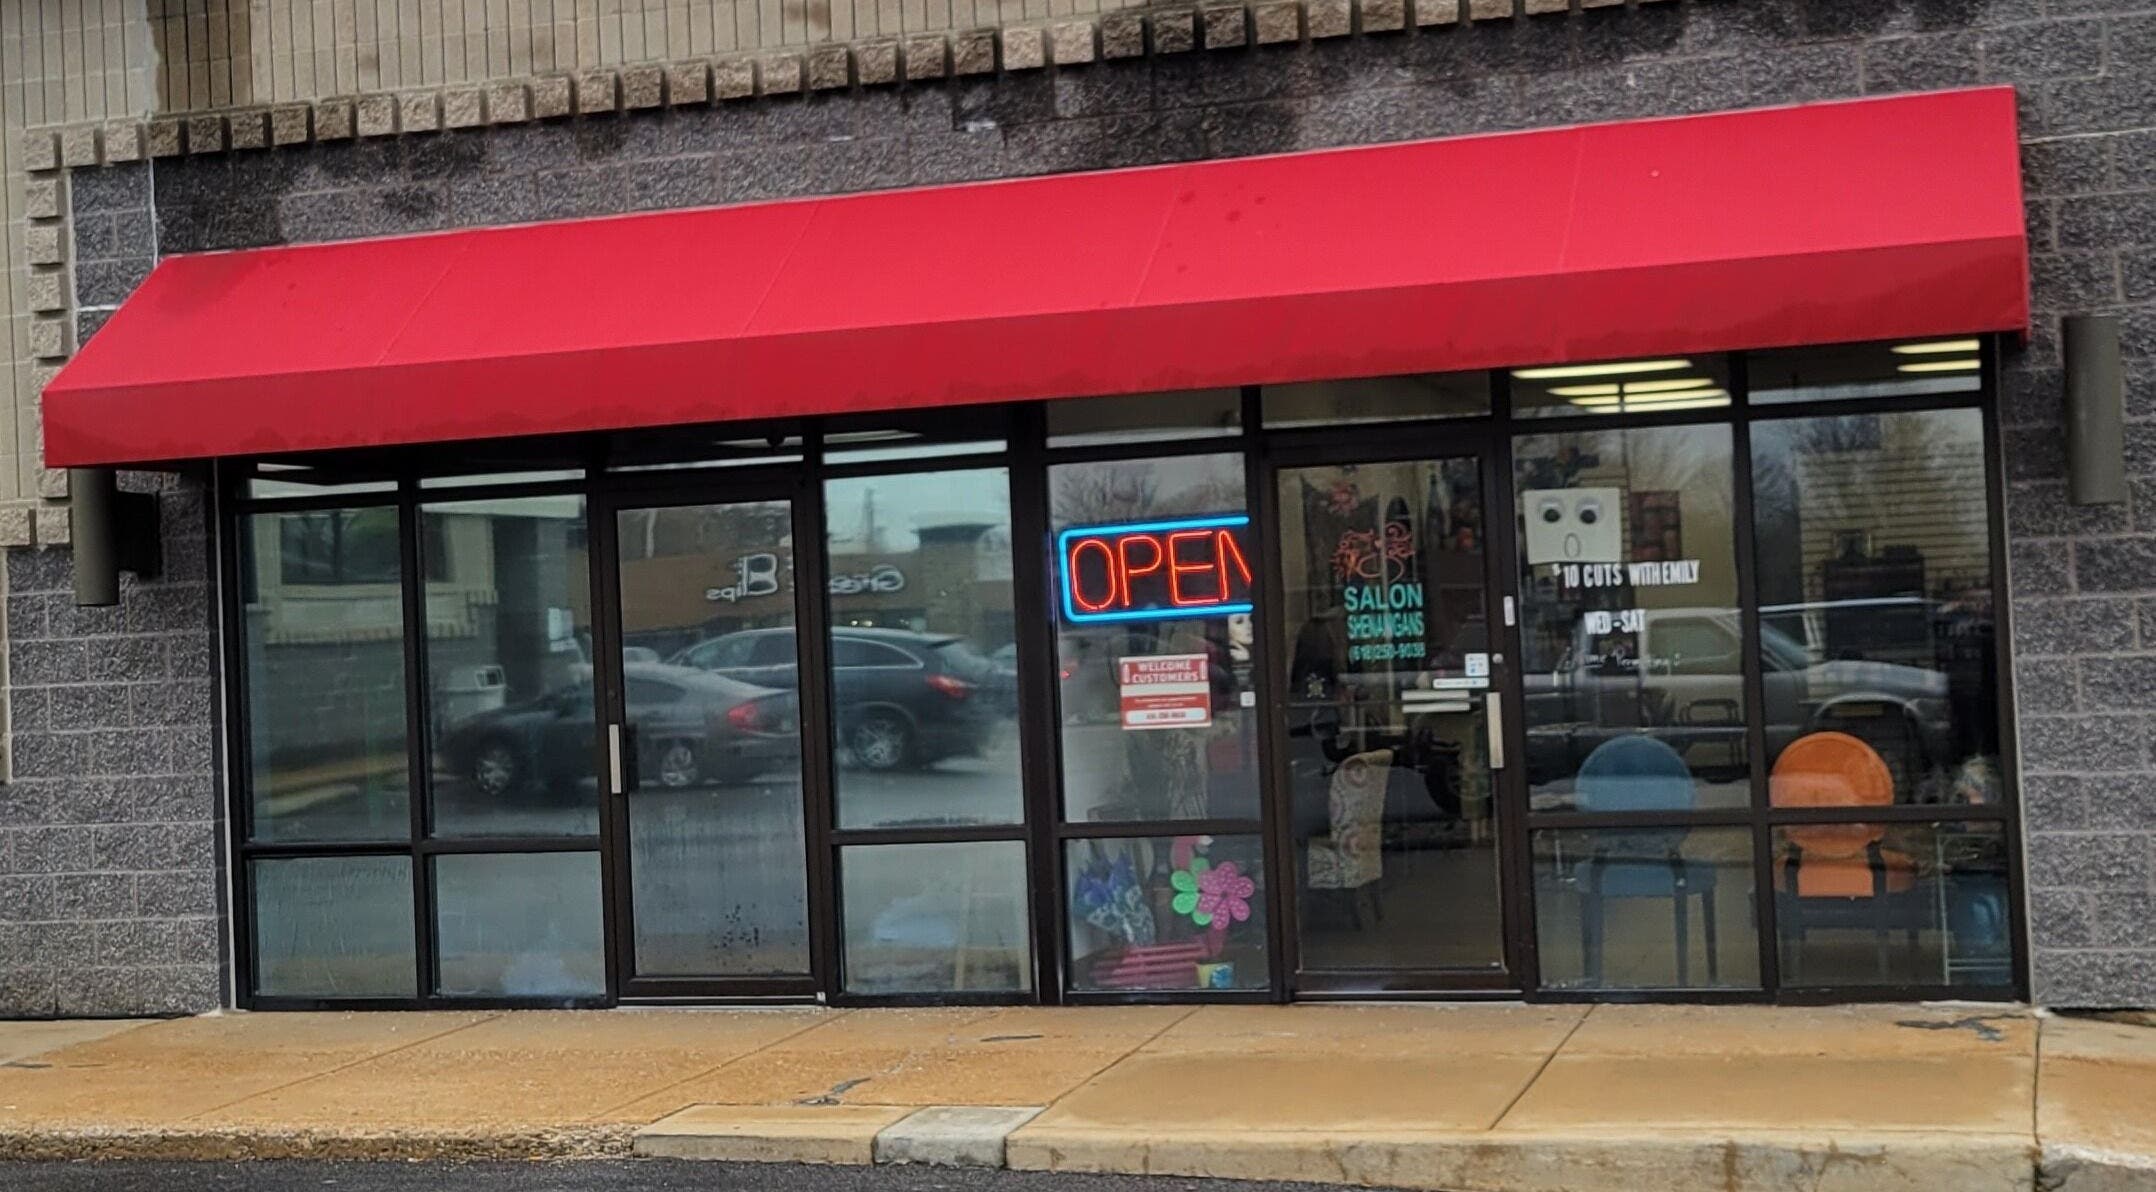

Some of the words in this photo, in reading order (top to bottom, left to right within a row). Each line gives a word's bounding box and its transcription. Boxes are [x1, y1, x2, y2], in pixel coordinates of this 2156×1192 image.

[1071, 529, 1251, 611] OPEN
[1583, 563, 1623, 587] CUTS
[1344, 583, 1423, 611] SALON
[1131, 671, 1200, 684] CUSTOMERS
[1138, 659, 1192, 672] WELCOME
